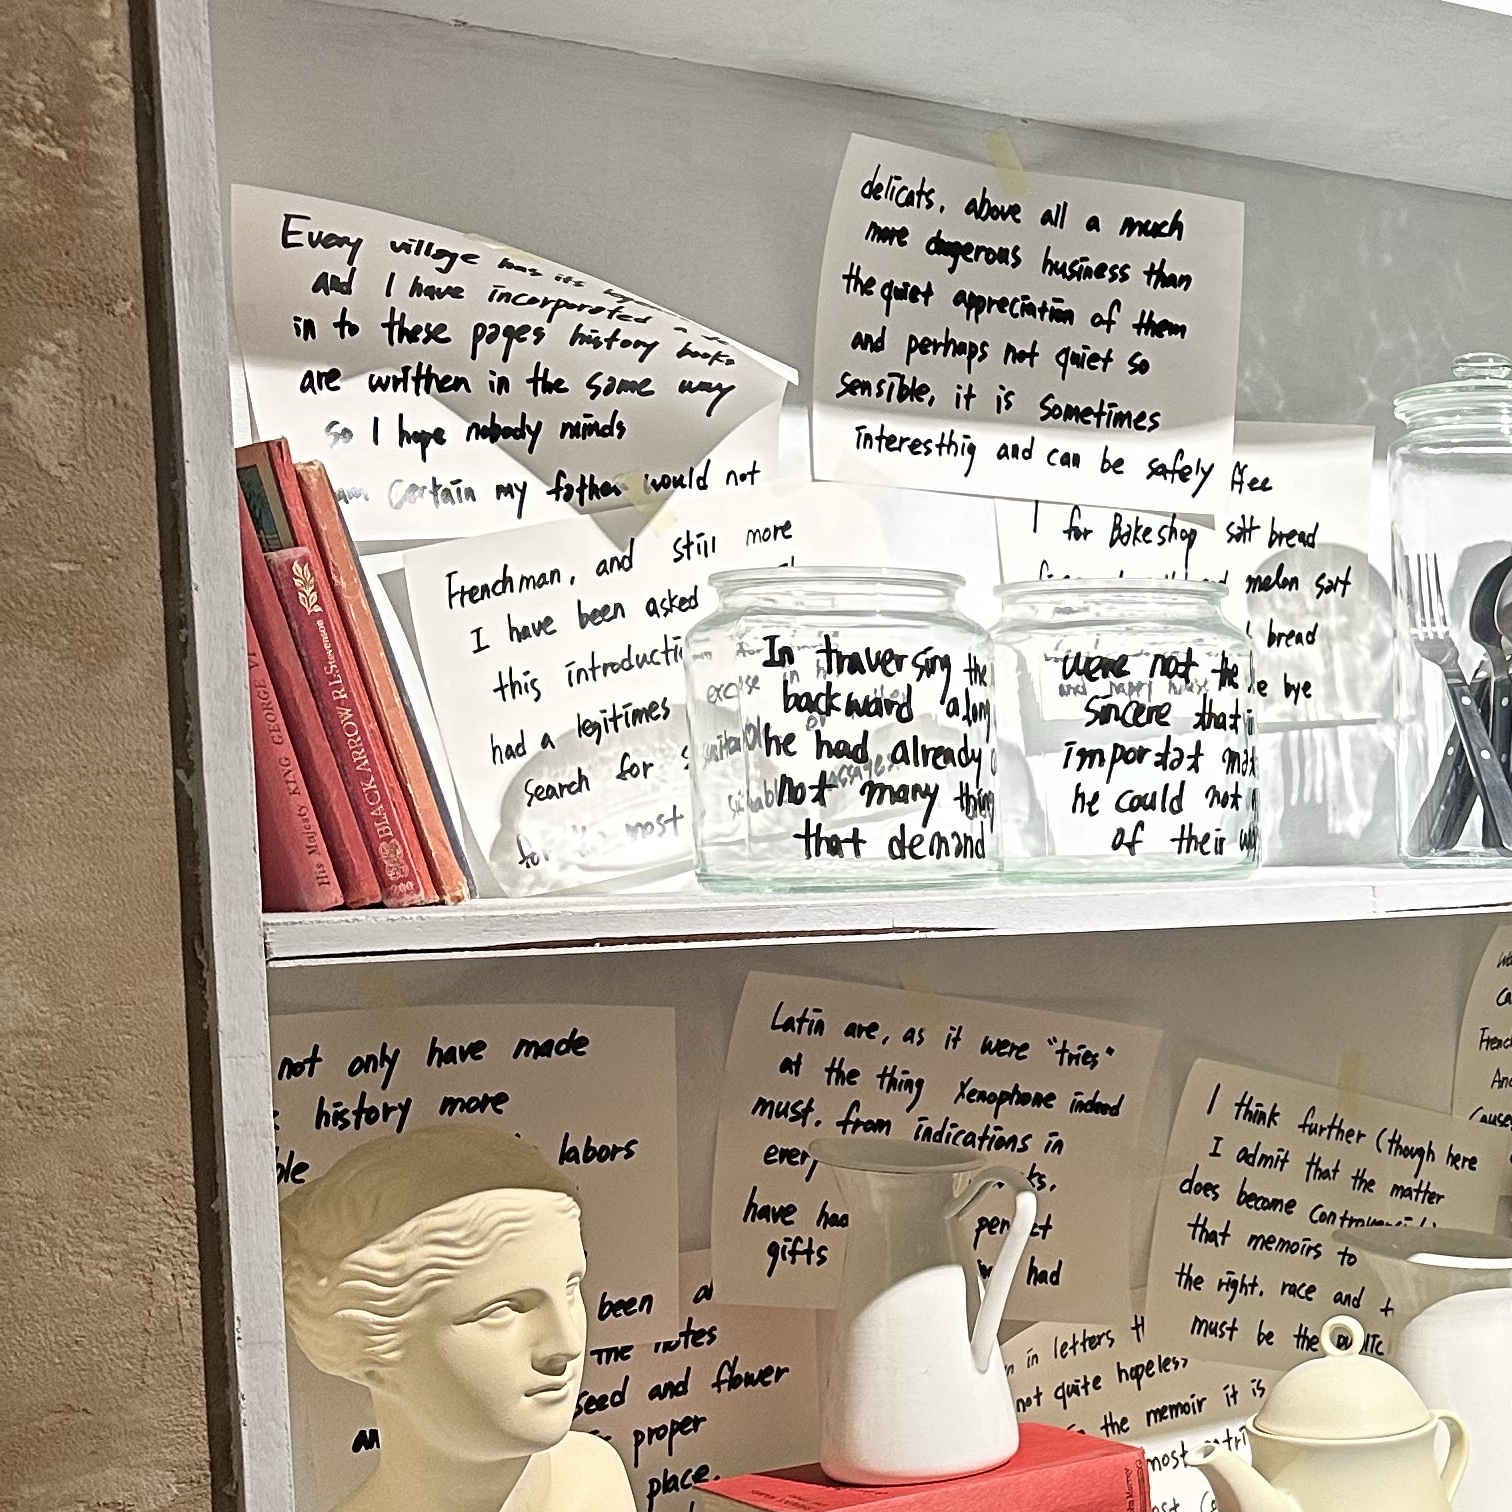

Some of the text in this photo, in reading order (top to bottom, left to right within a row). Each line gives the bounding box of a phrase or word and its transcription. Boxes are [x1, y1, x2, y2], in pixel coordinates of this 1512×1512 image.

[964, 186, 1184, 241] above all much
[390, 239, 480, 274] village
[865, 221, 1192, 292] more business than
[312, 267, 464, 300] and have
[842, 262, 1121, 334] the quiet of
[381, 306, 452, 347] these
[470, 323, 545, 363] pages
[569, 323, 660, 363] history
[851, 325, 1113, 381] and perhaps not quiet
[300, 361, 569, 397] are in the
[955, 383, 1015, 414] it is
[399, 411, 543, 463] hope nobody
[496, 459, 761, 519] my would not
[997, 436, 1214, 498] and can be safely
[596, 520, 792, 577] and still more
[1268, 516, 1319, 549] bread
[470, 585, 698, 654] I have been asked
[762, 635, 794, 668] In
[1149, 646, 1198, 681] not
[493, 666, 541, 702] this
[491, 729, 526, 765] had
[616, 752, 654, 781] for
[764, 723, 981, 781] he had already
[255, 679, 330, 886] His Majesty KING GEORGE
[335, 705, 394, 837] BLACK ARROW
[777, 771, 939, 828] not many
[1072, 780, 1242, 817] he could not
[793, 818, 985, 860] that demand
[1111, 820, 1226, 856] of their
[771, 1001, 1030, 1061] Latin as it were
[278, 1027, 590, 1090] not only have made
[779, 1052, 925, 1113] at the thing
[315, 1089, 509, 1136] history more
[835, 1100, 1064, 1155] from indications in
[1234, 1091, 1477, 1171] think further here
[558, 1132, 639, 1165] labors
[1179, 1163, 1220, 1201] does
[1236, 1141, 1445, 1205] admit that matter
[743, 1185, 797, 1226] have
[1187, 1212, 1322, 1260] that memoirs
[767, 1236, 1063, 1287] gifts had
[1281, 1281, 1365, 1309] race and
[1054, 1329, 1115, 1359] letters
[1191, 1315, 1238, 1342] must
[648, 1355, 790, 1401] and flower
[1054, 1375, 1102, 1410] quite
[1146, 1393, 1207, 1427] memoir
[633, 1414, 706, 1466] proper
